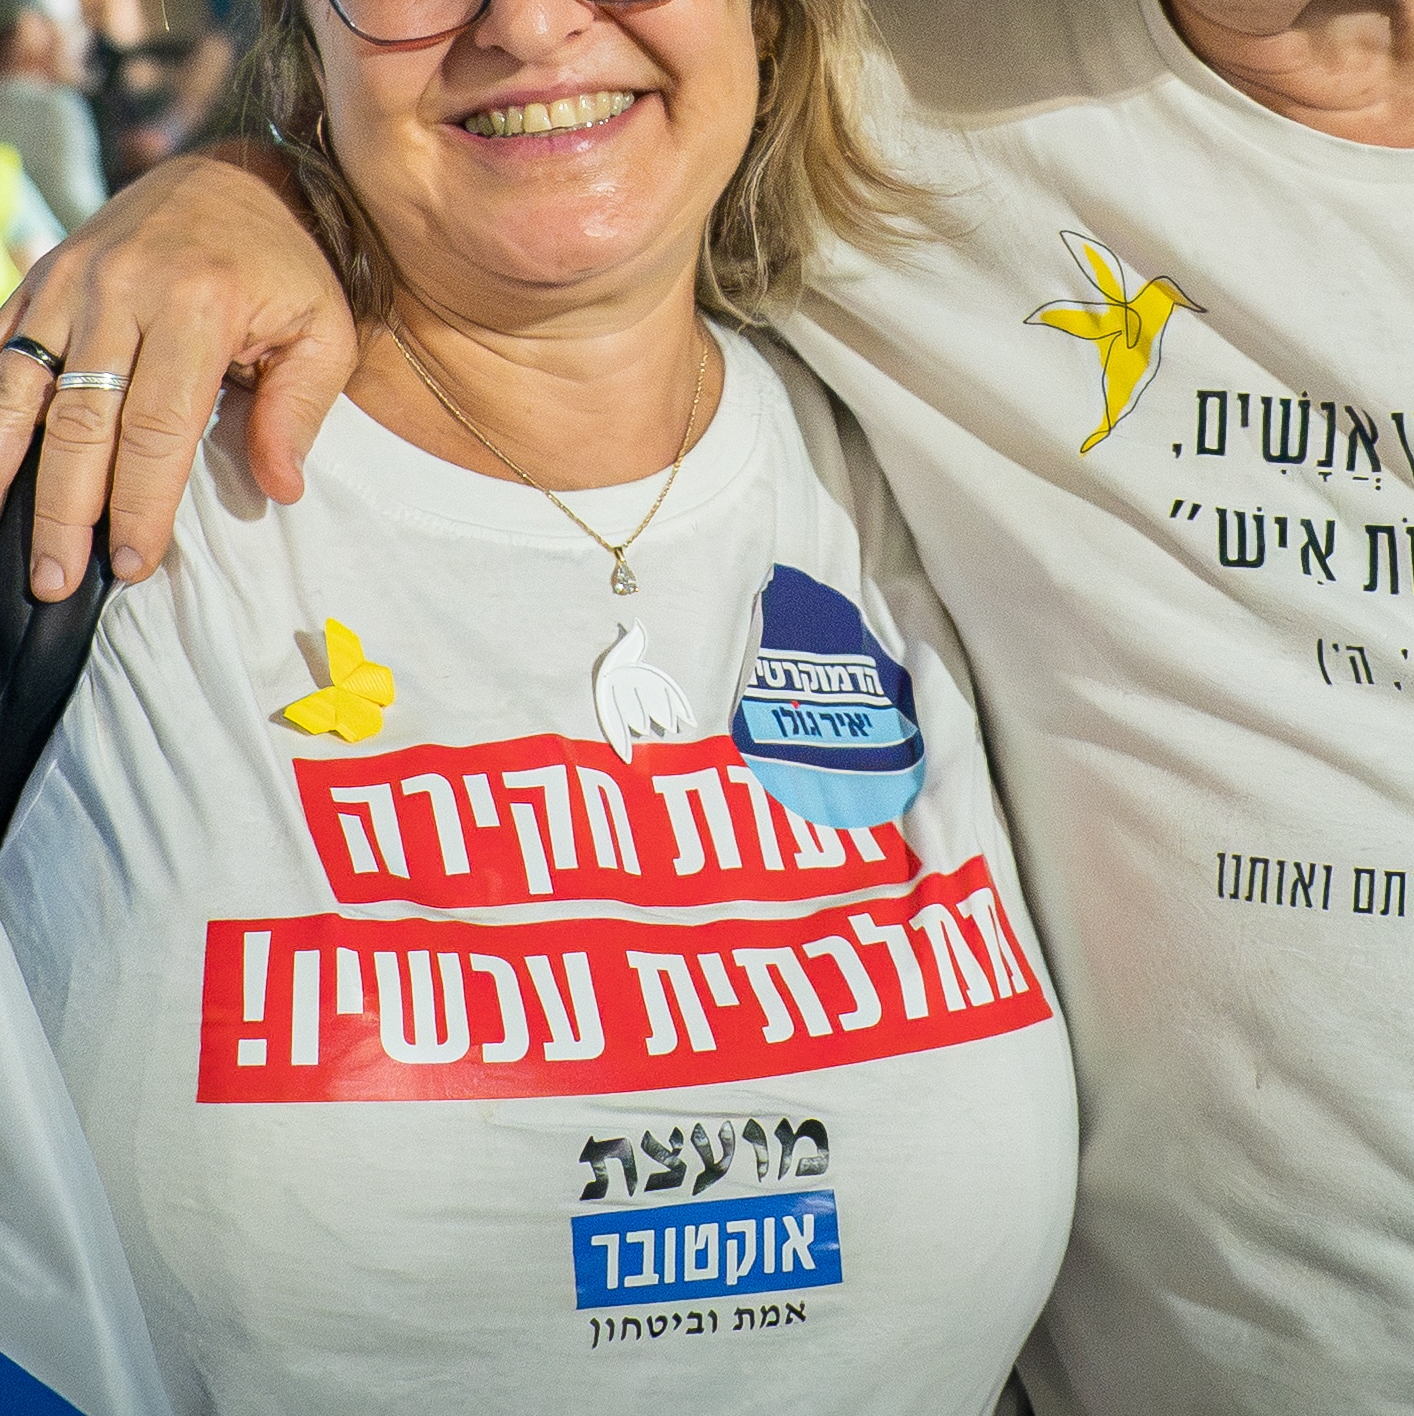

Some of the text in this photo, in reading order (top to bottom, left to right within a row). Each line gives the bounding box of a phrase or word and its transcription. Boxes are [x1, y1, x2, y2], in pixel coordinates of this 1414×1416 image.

[771, 705, 873, 738] יאיר גולן
[330, 764, 643, 895] חקירה
[1216, 852, 1333, 911] ואותנו
[236, 888, 1029, 1068] ממלכתית עכשיו!
[579, 1117, 830, 1202] מועצת
[590, 1213, 817, 1290] אוקטובר
[589, 1300, 807, 1349] אמת וביטחון
